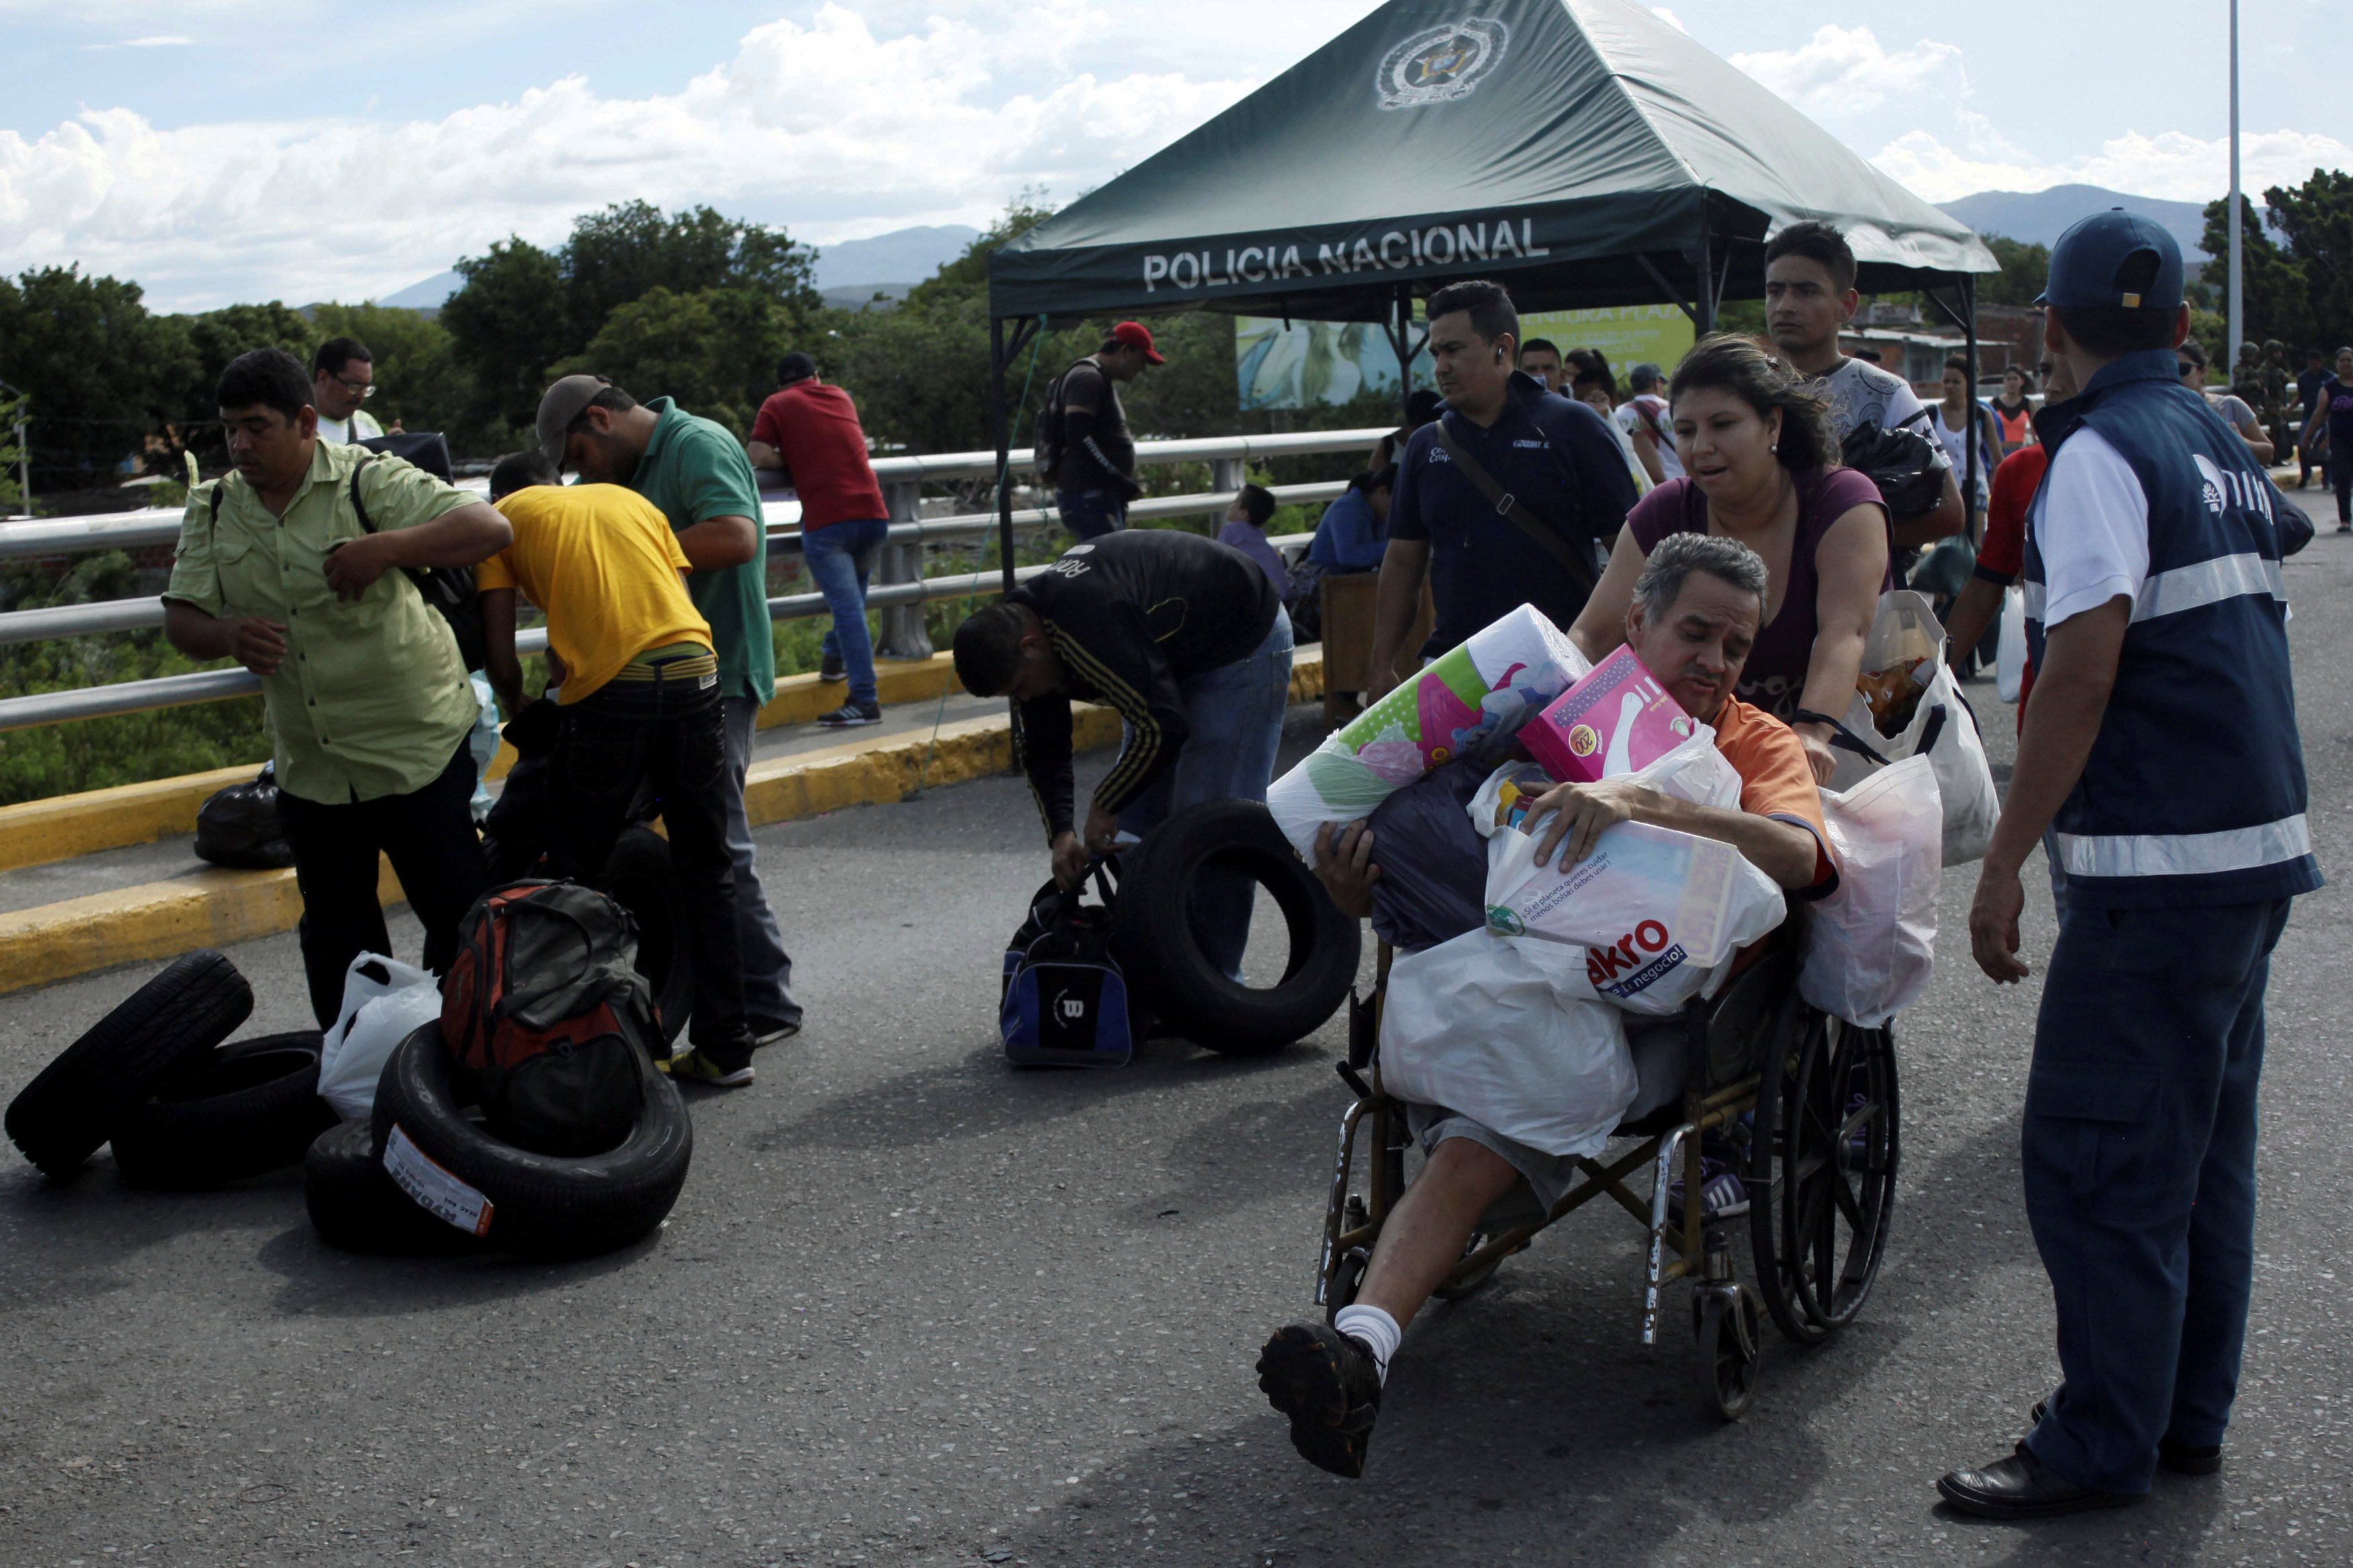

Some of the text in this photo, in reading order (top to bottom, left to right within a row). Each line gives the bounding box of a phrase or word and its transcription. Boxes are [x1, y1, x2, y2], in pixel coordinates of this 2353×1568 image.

[1144, 218, 1550, 292] POLICIA NACIONAL
[1575, 732, 1593, 753] 200
[1530, 904, 1554, 922] menos
[1552, 889, 1574, 905] bolsas
[1573, 873, 1594, 891] debes
[1532, 901, 1540, 911] el
[1539, 885, 1564, 906] planeta
[1564, 866, 1588, 888] quieres
[1587, 852, 1608, 870] cuidar
[1585, 919, 1669, 985] akro
[1633, 946, 1684, 989] negocio!
